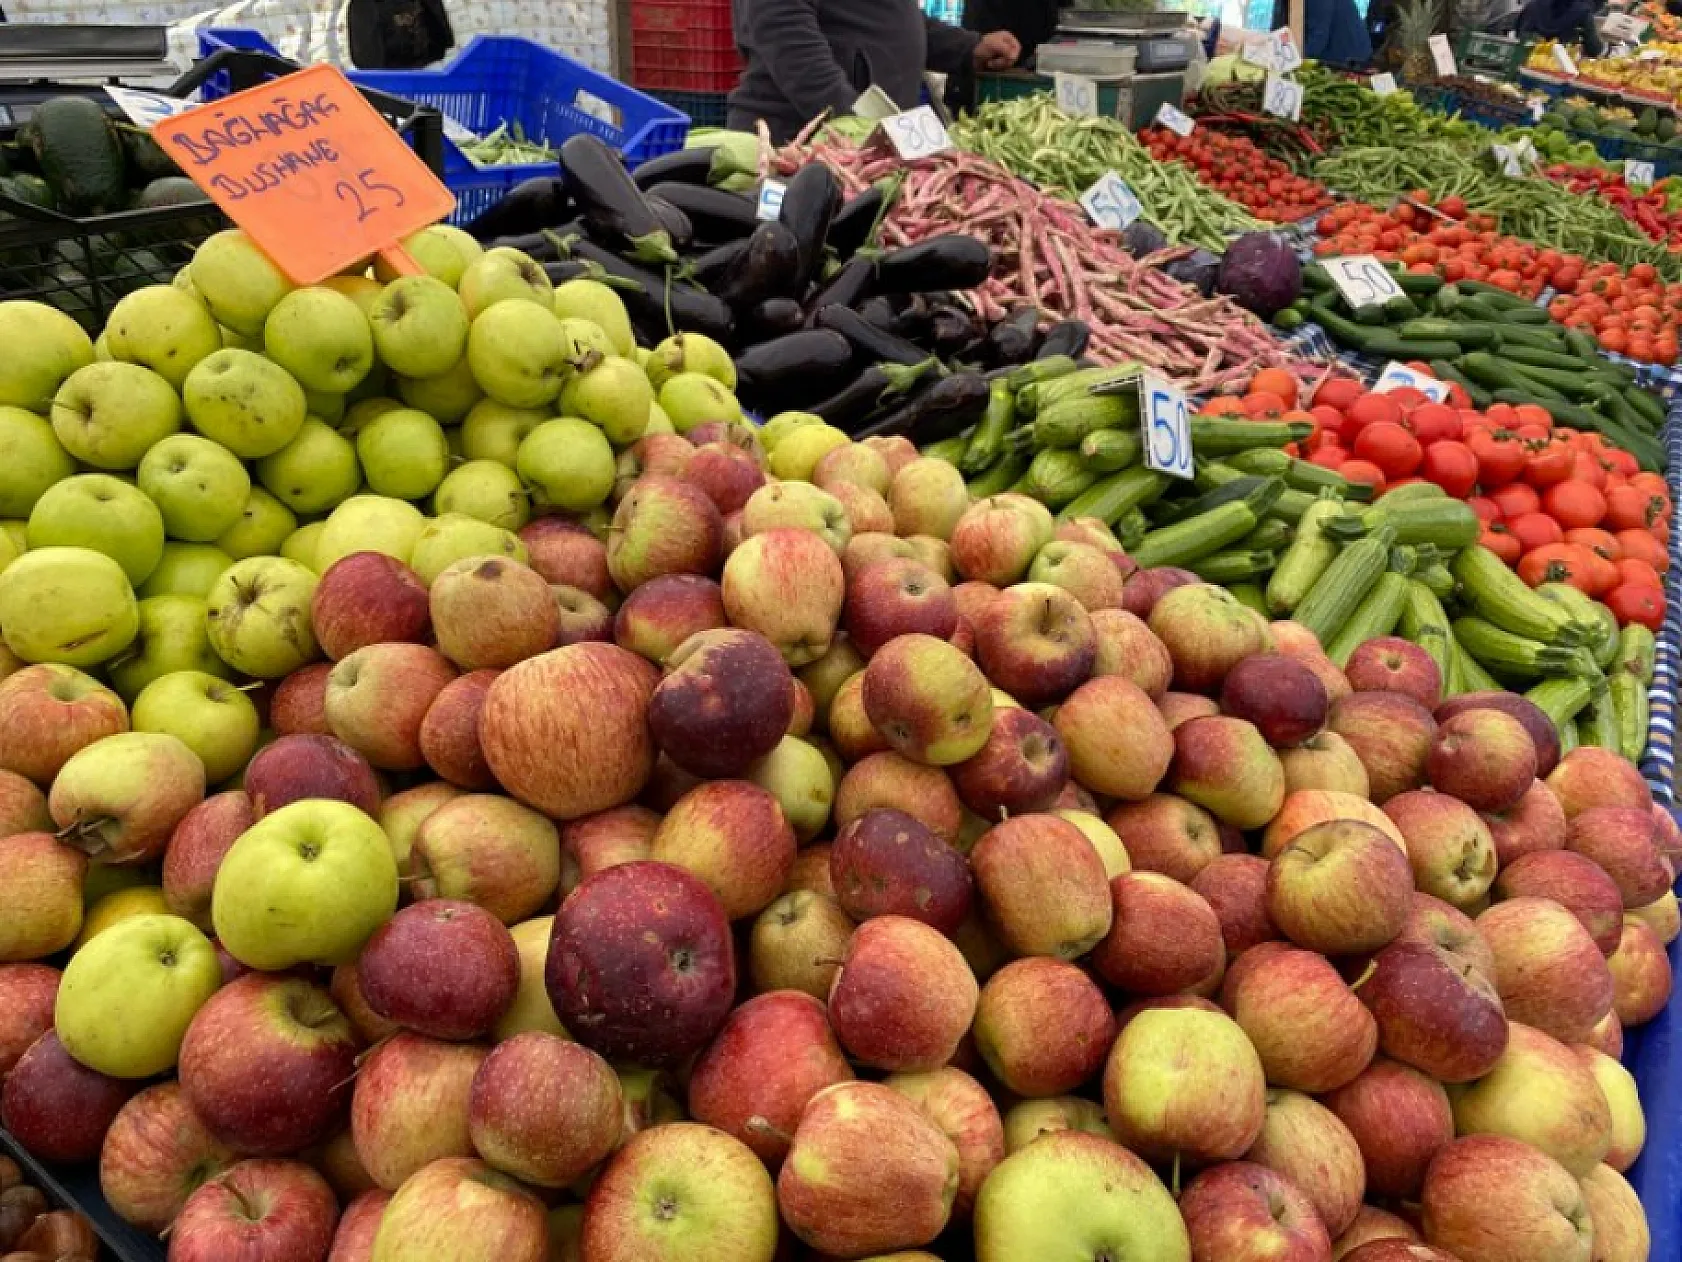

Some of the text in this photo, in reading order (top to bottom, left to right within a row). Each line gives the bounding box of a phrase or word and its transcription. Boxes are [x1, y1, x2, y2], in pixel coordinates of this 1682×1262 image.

[897, 113, 943, 150] 80
[335, 168, 405, 223] 25
[1090, 178, 1138, 226] 50
[1341, 260, 1396, 299] 50
[1151, 389, 1190, 471] 50
